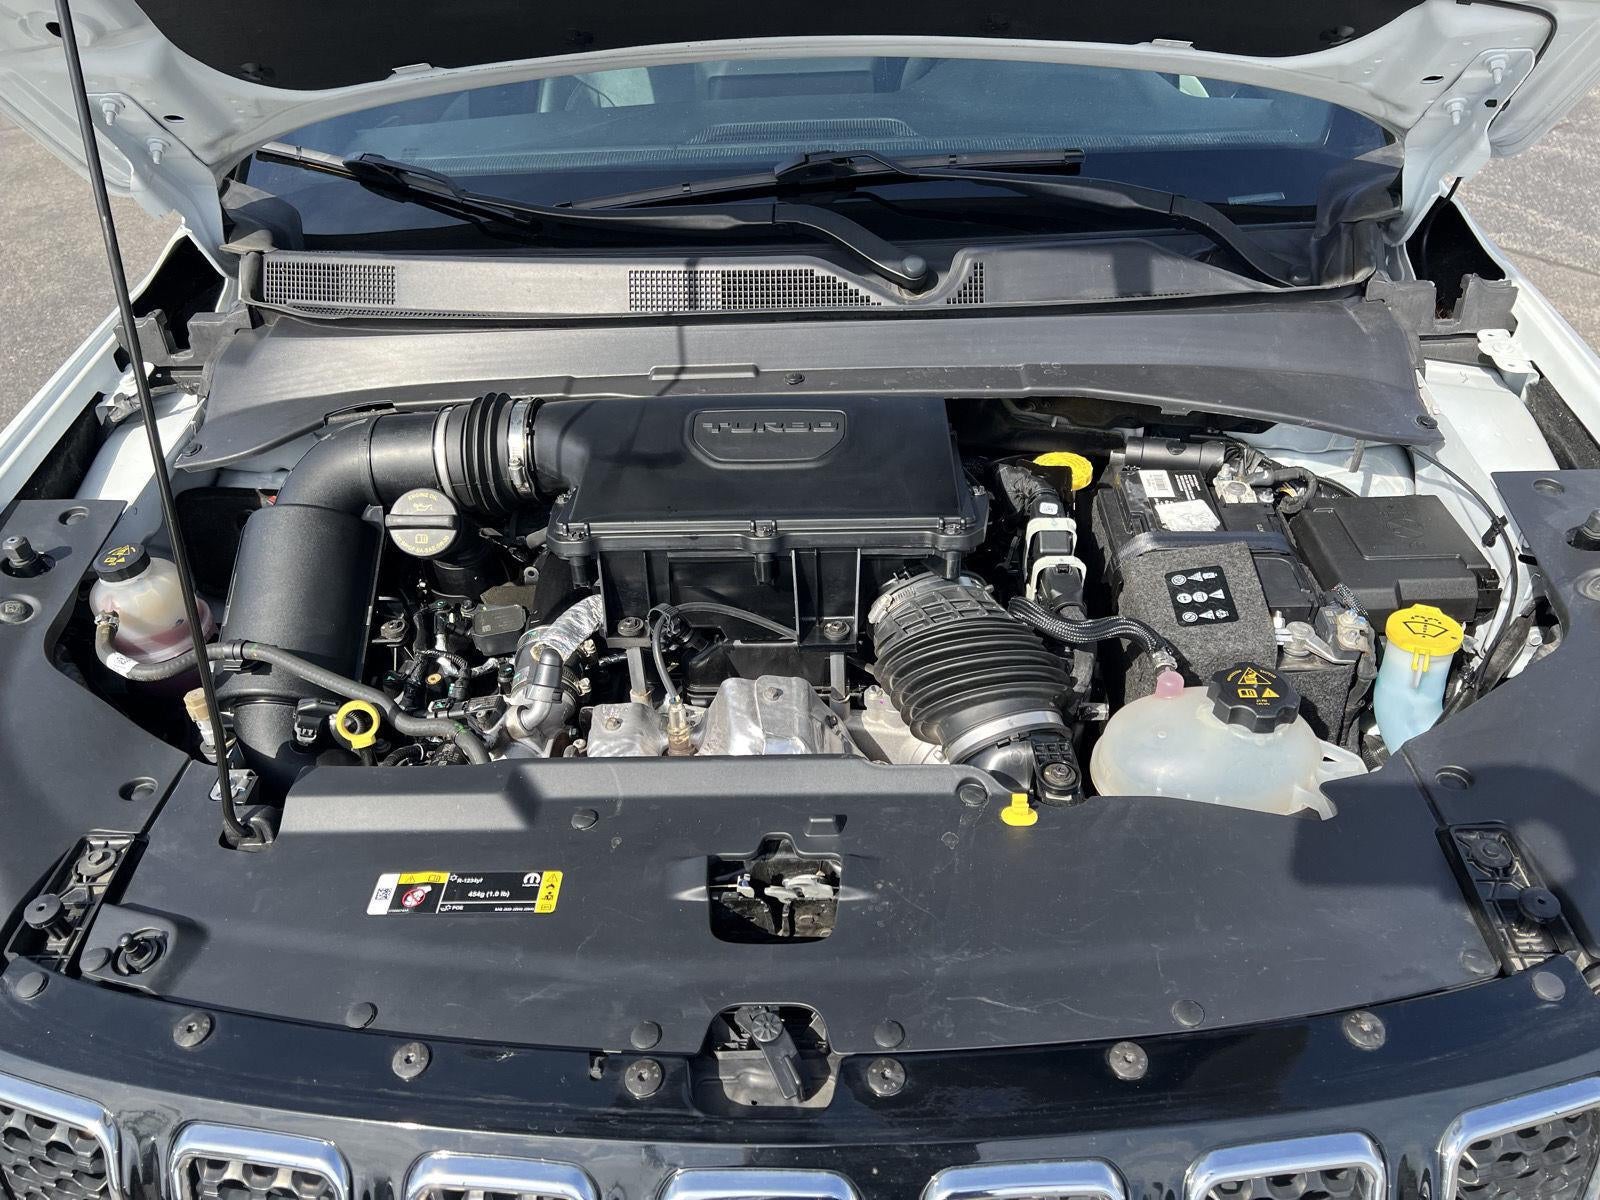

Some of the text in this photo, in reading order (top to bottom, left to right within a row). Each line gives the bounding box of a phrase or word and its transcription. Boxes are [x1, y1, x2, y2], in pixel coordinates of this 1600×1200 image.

[702, 422, 839, 433] TURBO
[408, 492, 438, 501] ENGINE OIL
[500, 890, 510, 898] lb)
